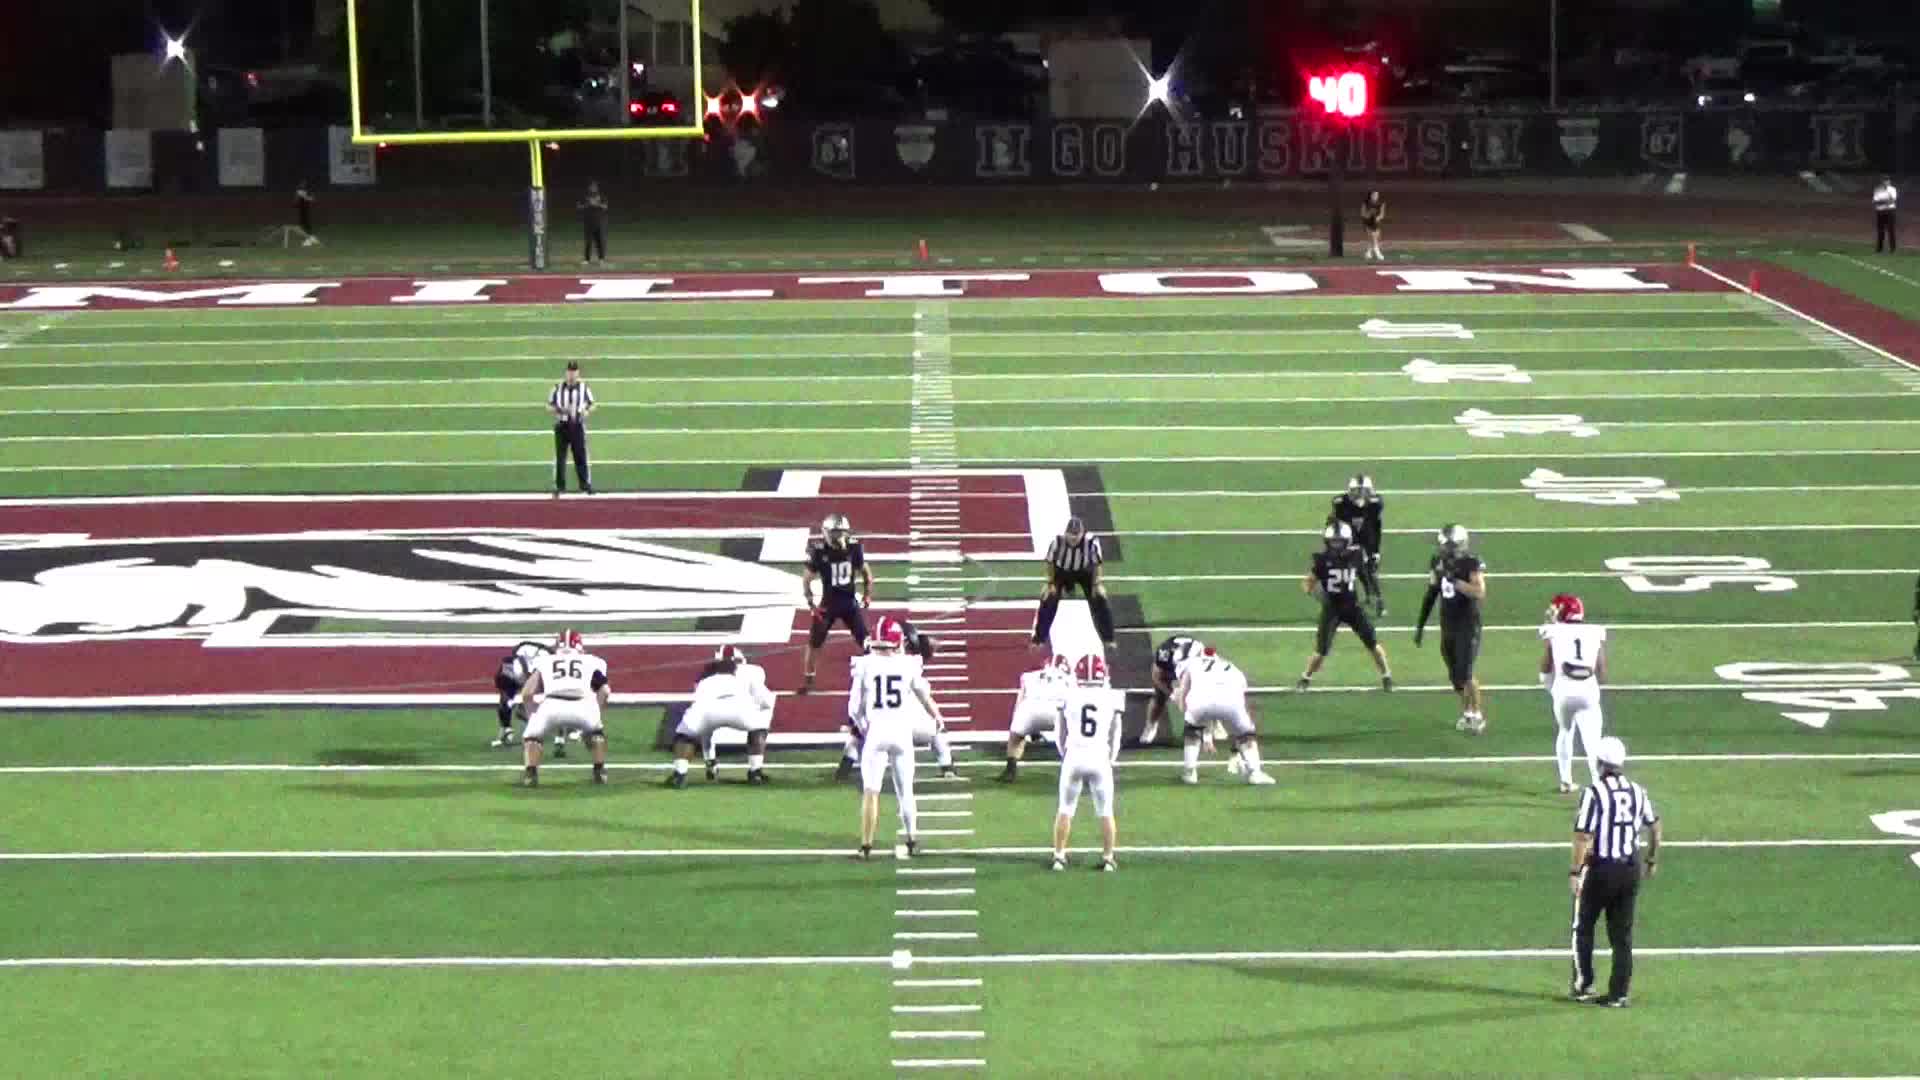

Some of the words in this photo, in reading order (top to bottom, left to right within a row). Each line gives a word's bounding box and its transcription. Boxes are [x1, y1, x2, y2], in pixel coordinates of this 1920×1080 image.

[1308, 71, 1367, 118] 40
[1051, 123, 1125, 176] GO
[1166, 119, 1449, 174] HUSKIES
[1520, 476, 1681, 505] 40
[831, 561, 852, 586] 10
[1327, 568, 1357, 593] 24
[1603, 555, 1798, 592] 50
[1574, 638, 1583, 660] 1
[552, 660, 583, 679] 56
[872, 675, 902, 709] 15
[1081, 704, 1098, 737] 6
[1615, 791, 1633, 823] R
